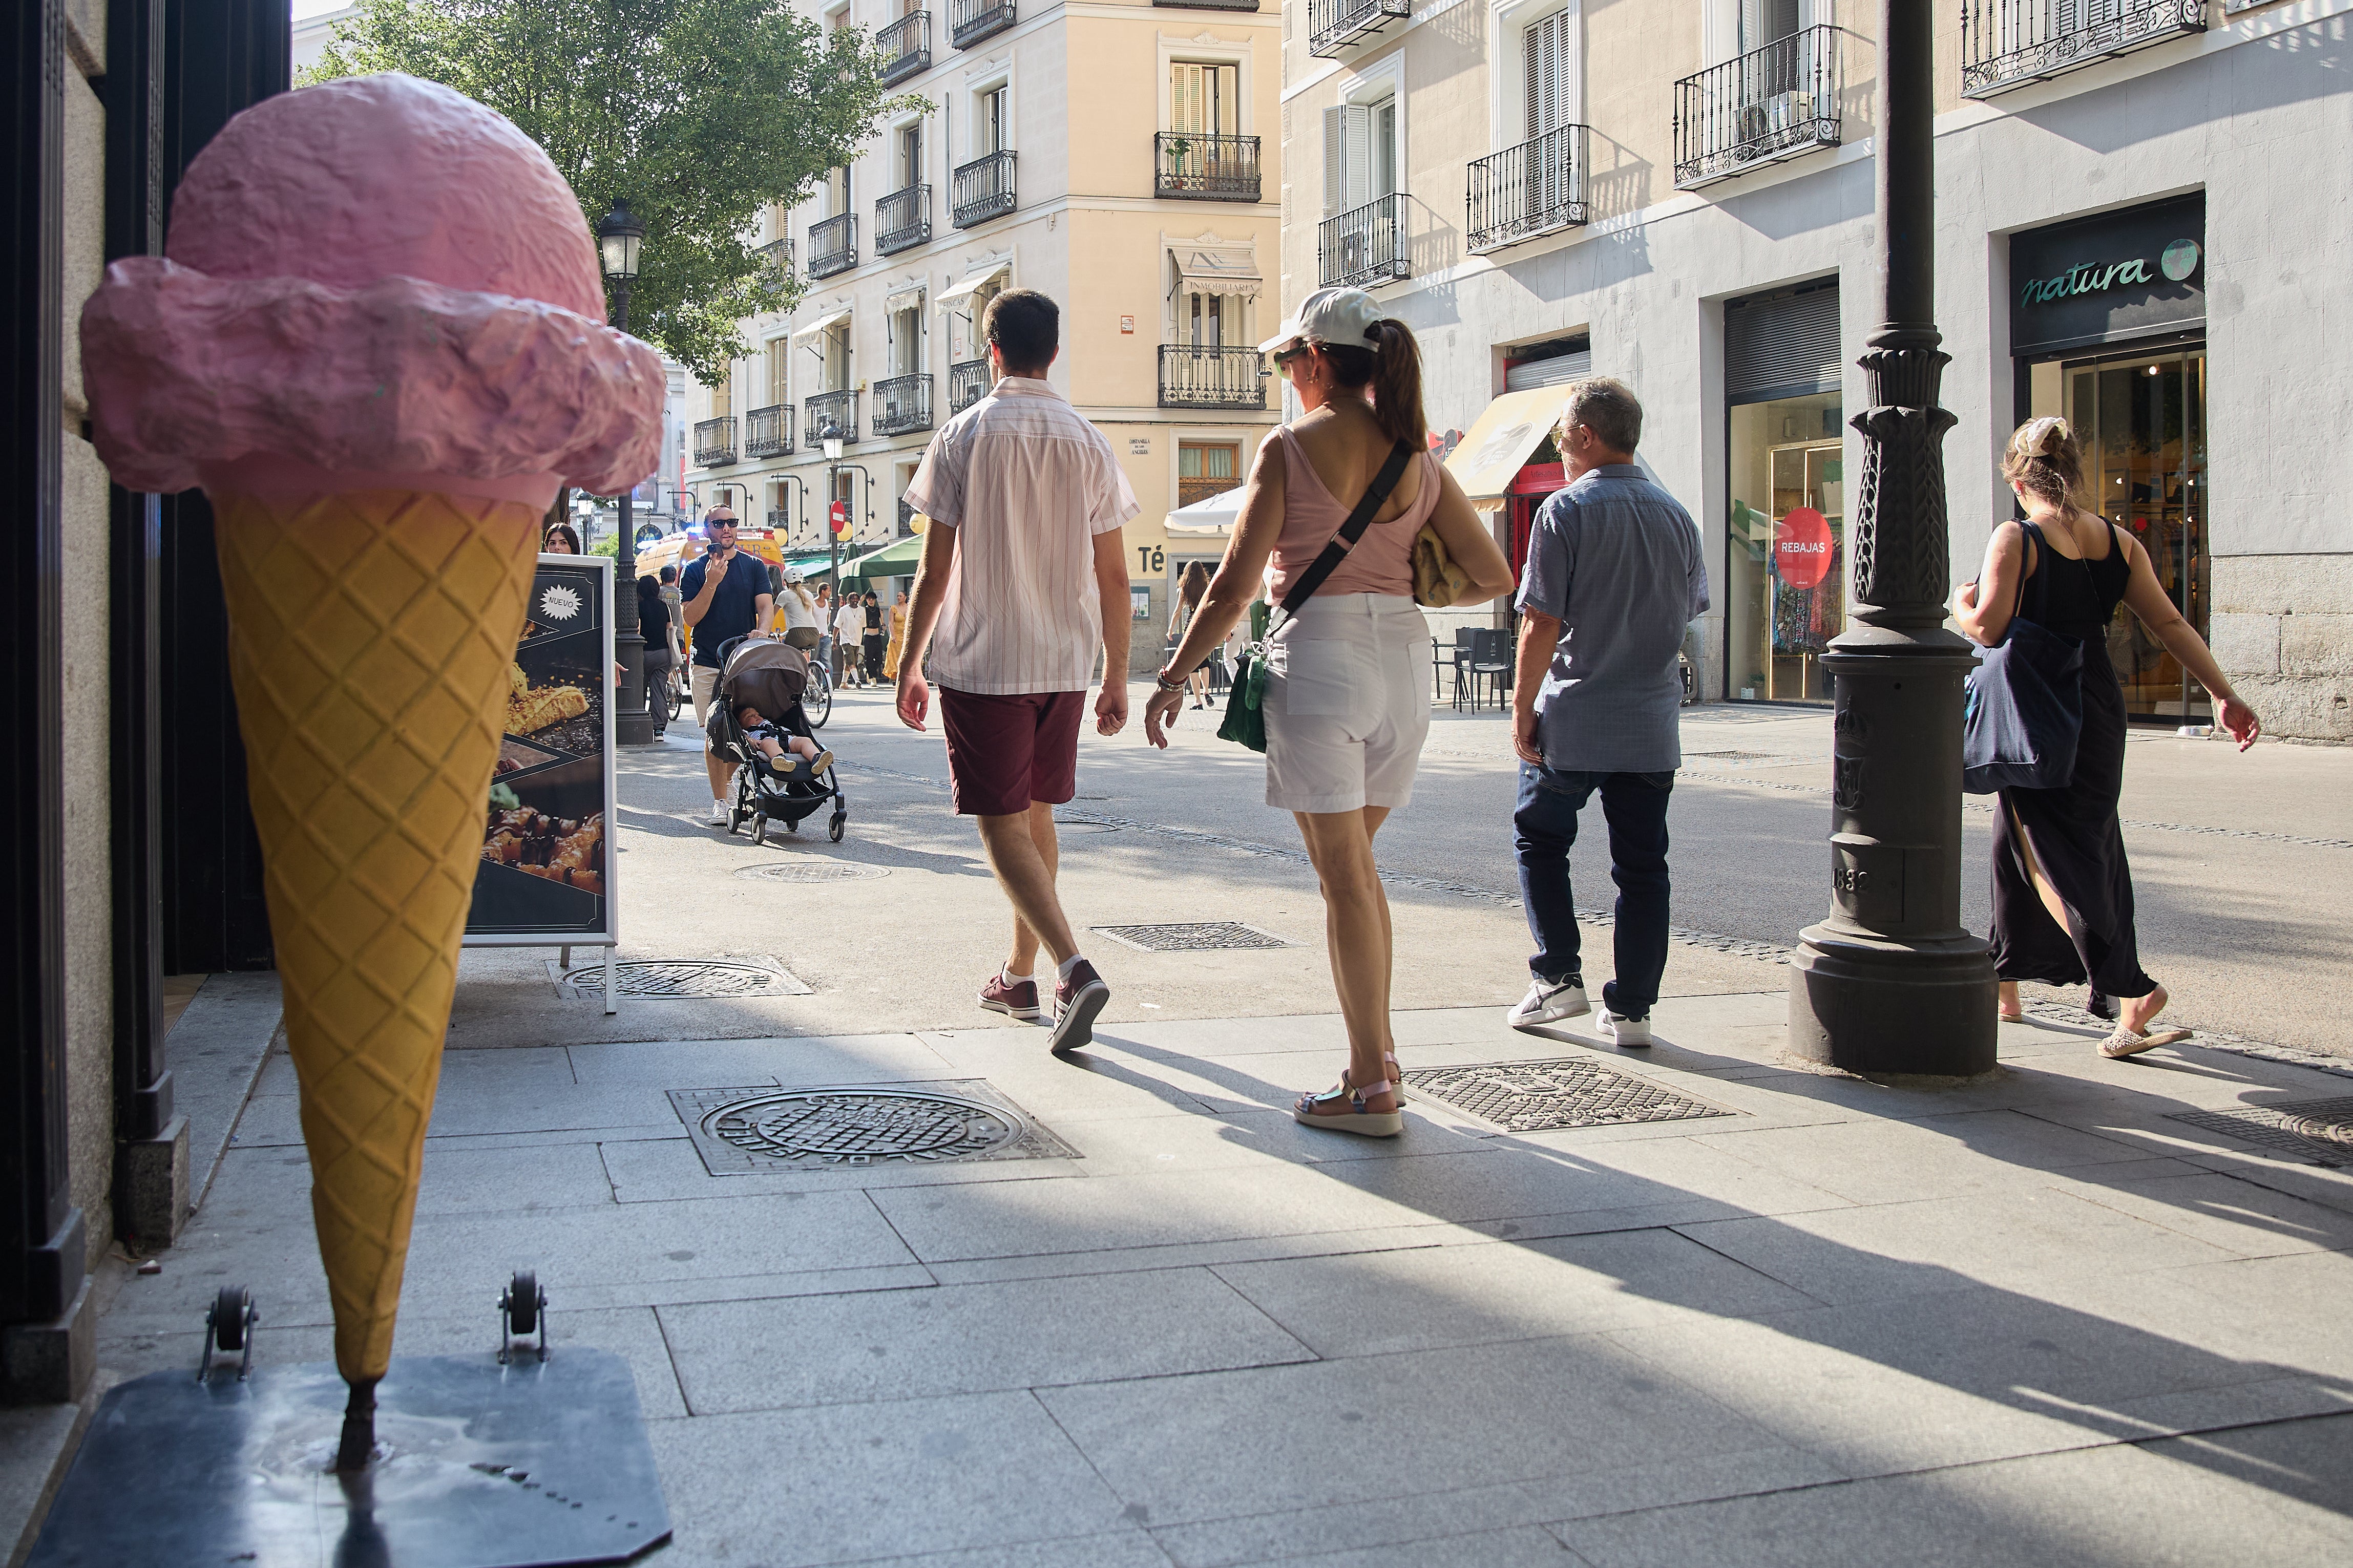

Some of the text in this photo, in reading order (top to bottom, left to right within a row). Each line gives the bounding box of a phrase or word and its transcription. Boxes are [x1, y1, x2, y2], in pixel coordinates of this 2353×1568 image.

[1190, 282, 1255, 291] INMOBILIARIA
[2021, 259, 2153, 308] natura
[892, 297, 910, 307] FISCAL
[943, 298, 964, 309] FINCAS
[1781, 542, 1825, 553] REBAJAS
[1138, 544, 1164, 573] Té
[549, 597, 574, 608] NUEVO
[806, 1096, 986, 1121] REGISTRO
[818, 1154, 872, 1164] DE
